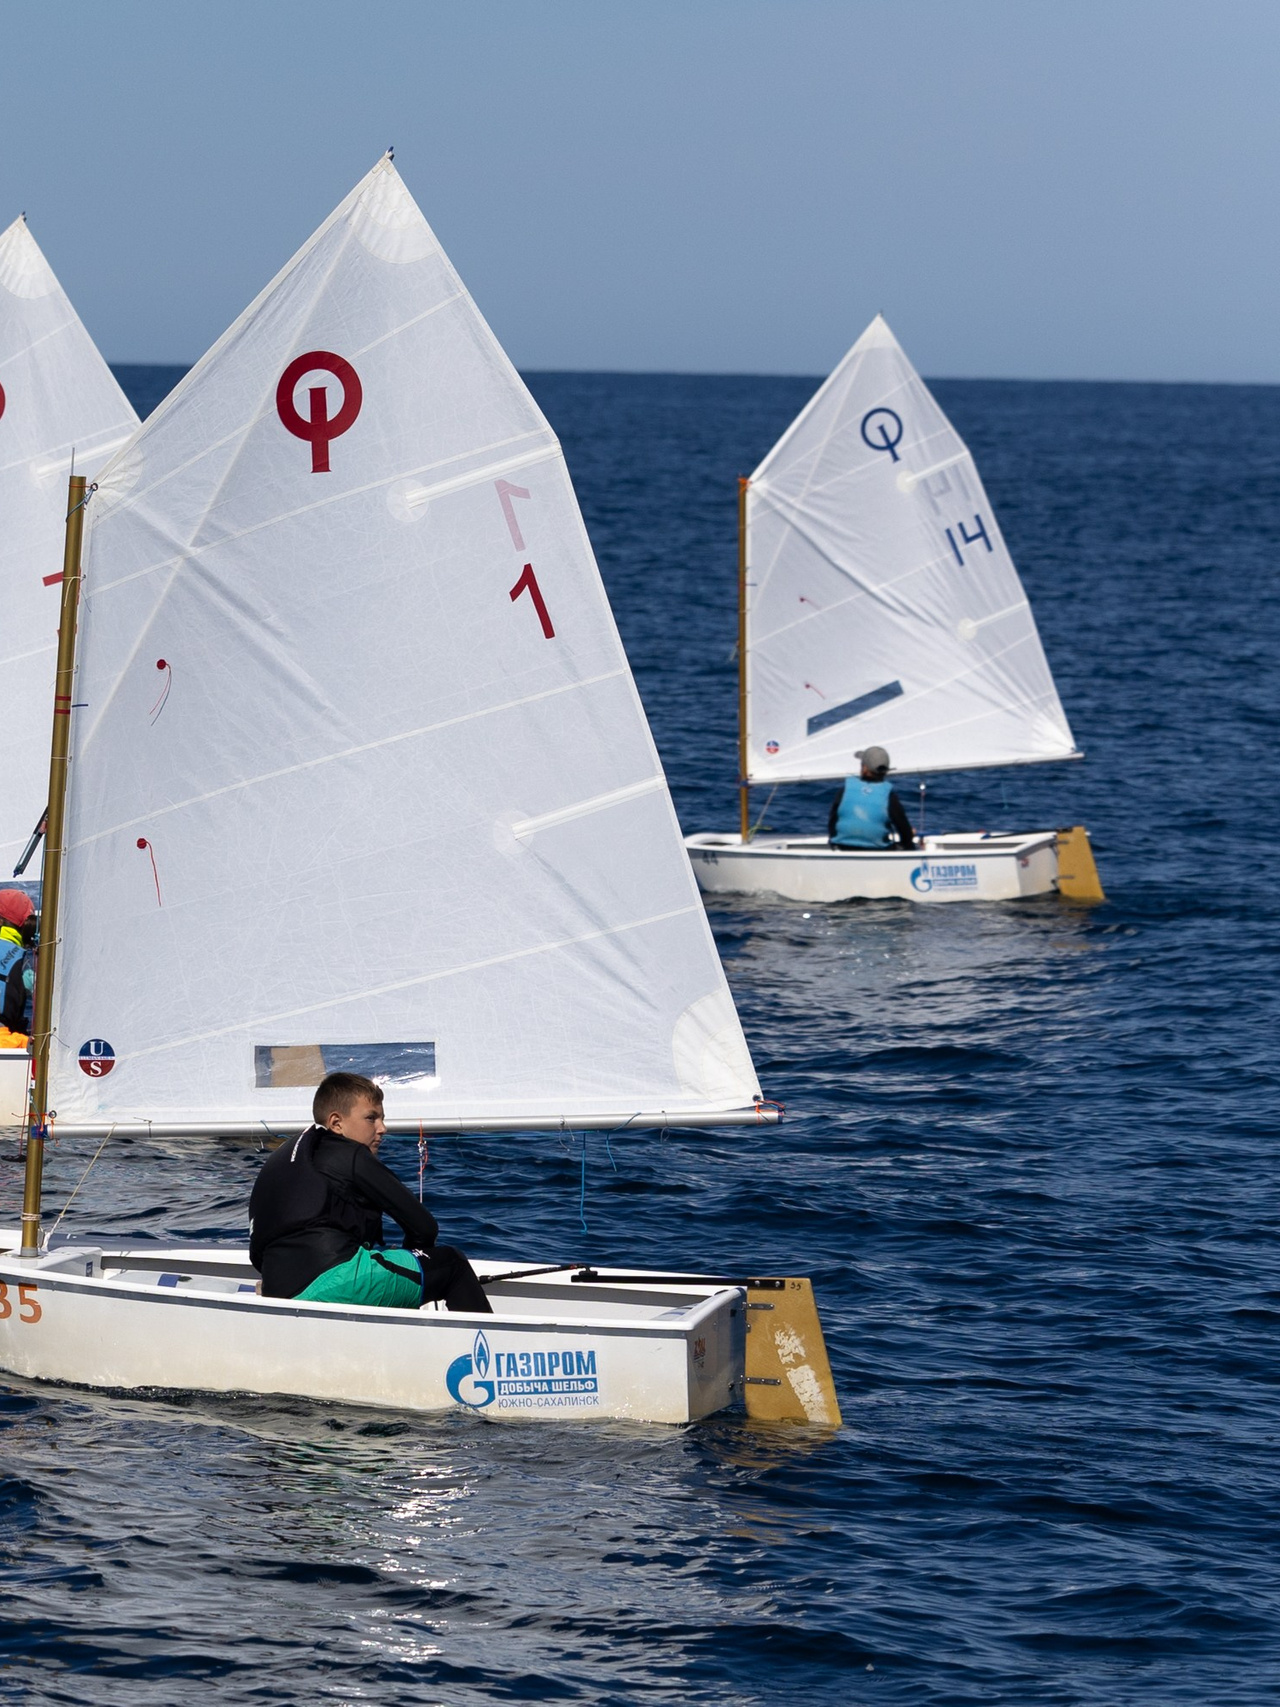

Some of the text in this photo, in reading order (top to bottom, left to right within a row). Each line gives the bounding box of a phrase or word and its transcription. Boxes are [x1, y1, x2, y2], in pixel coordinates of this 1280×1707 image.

[945, 514, 993, 567] 14
[509, 563, 555, 639] 1
[495, 1350, 597, 1377] ГАЗПРОМ
[500, 1380, 595, 1395] ДОБЫЧА ШЕЛЬФ
[498, 1395, 599, 1408] ЮЖНО-САХАЛИНСК
